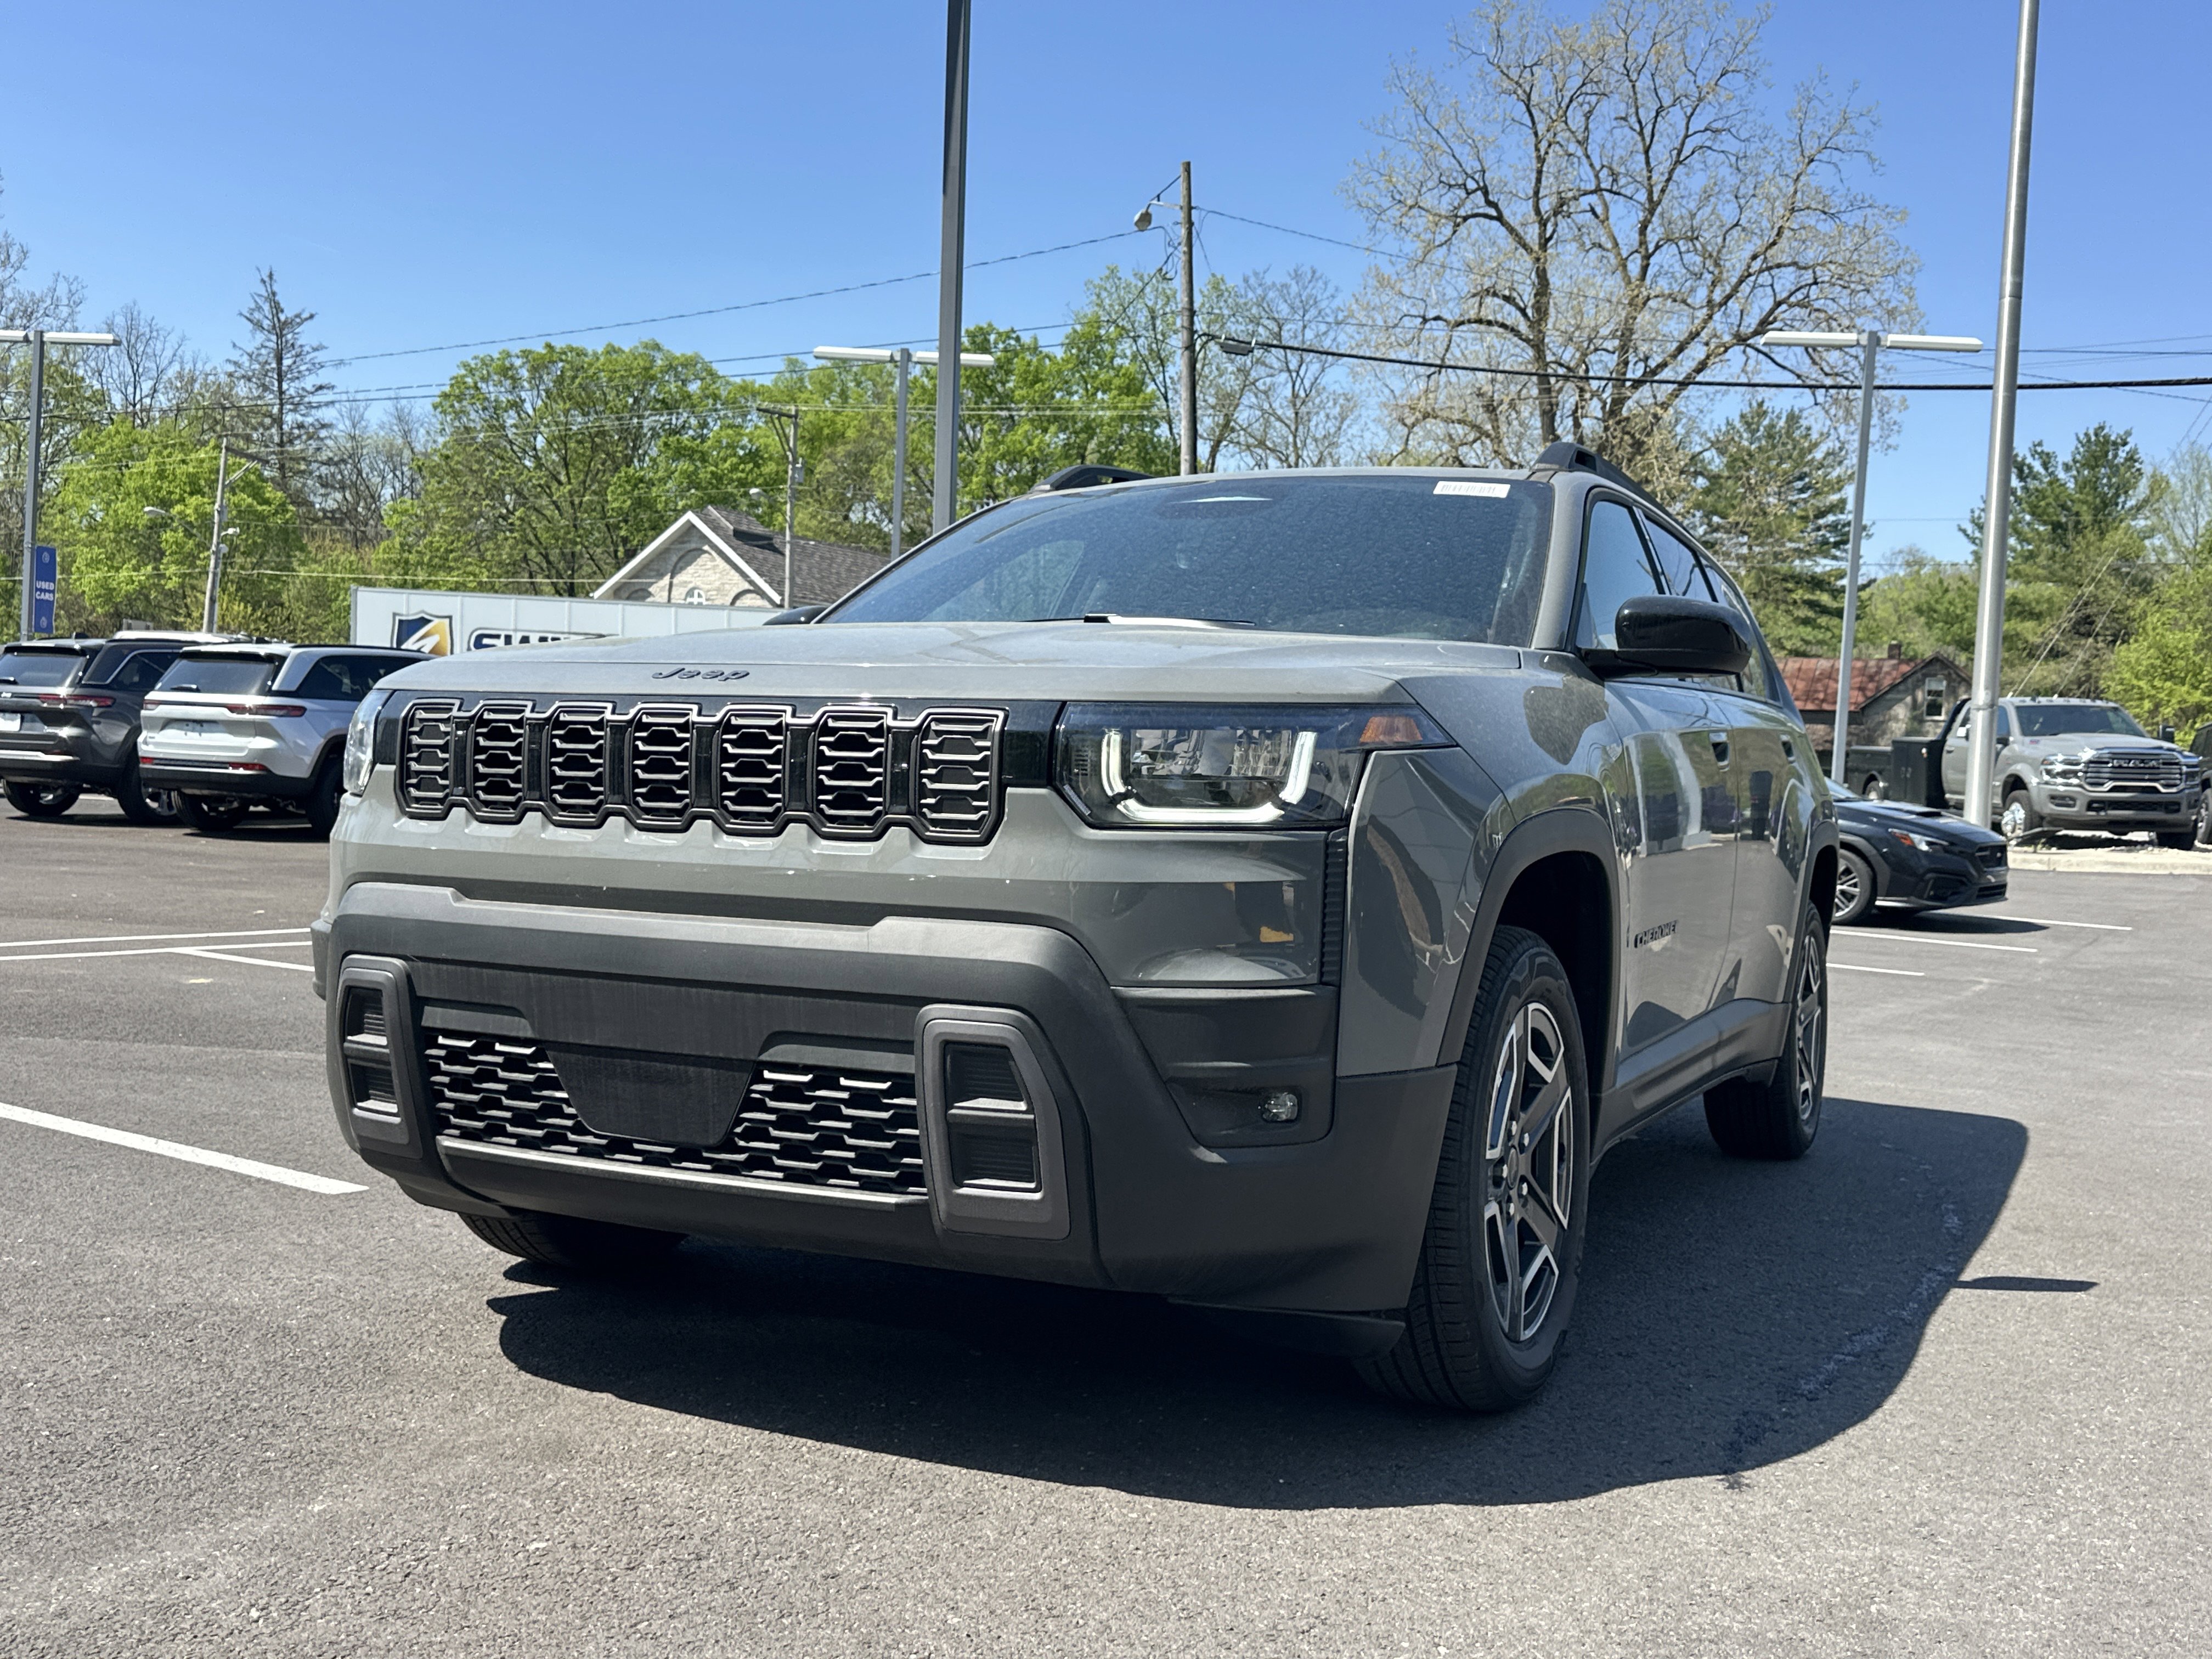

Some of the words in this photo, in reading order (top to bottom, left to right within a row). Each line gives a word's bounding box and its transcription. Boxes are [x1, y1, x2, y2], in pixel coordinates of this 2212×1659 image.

[36, 580, 54, 590] USED
[36, 591, 54, 601] CARS
[652, 667, 750, 681] Jeep
